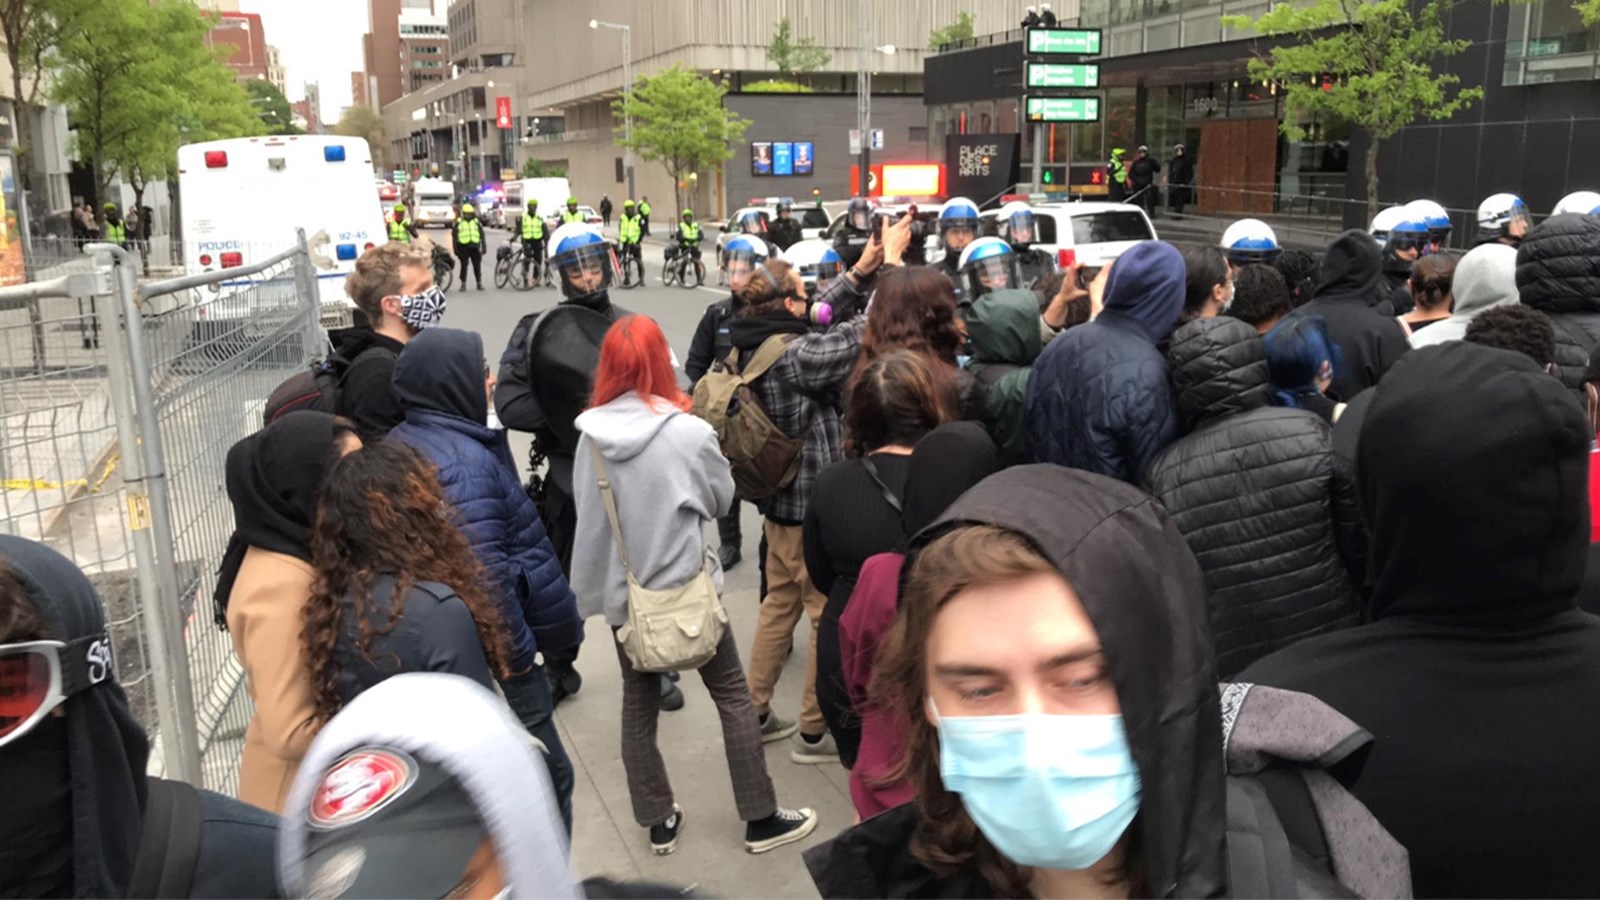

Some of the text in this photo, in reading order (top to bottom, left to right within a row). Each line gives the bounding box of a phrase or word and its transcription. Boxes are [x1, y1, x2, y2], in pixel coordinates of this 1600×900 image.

[1194, 97, 1217, 111] 1600
[960, 145, 997, 156] PLACE
[960, 155, 982, 166] DES
[959, 165, 990, 176] ARTS
[339, 231, 368, 240] 92-45
[198, 240, 240, 251] POLICE
